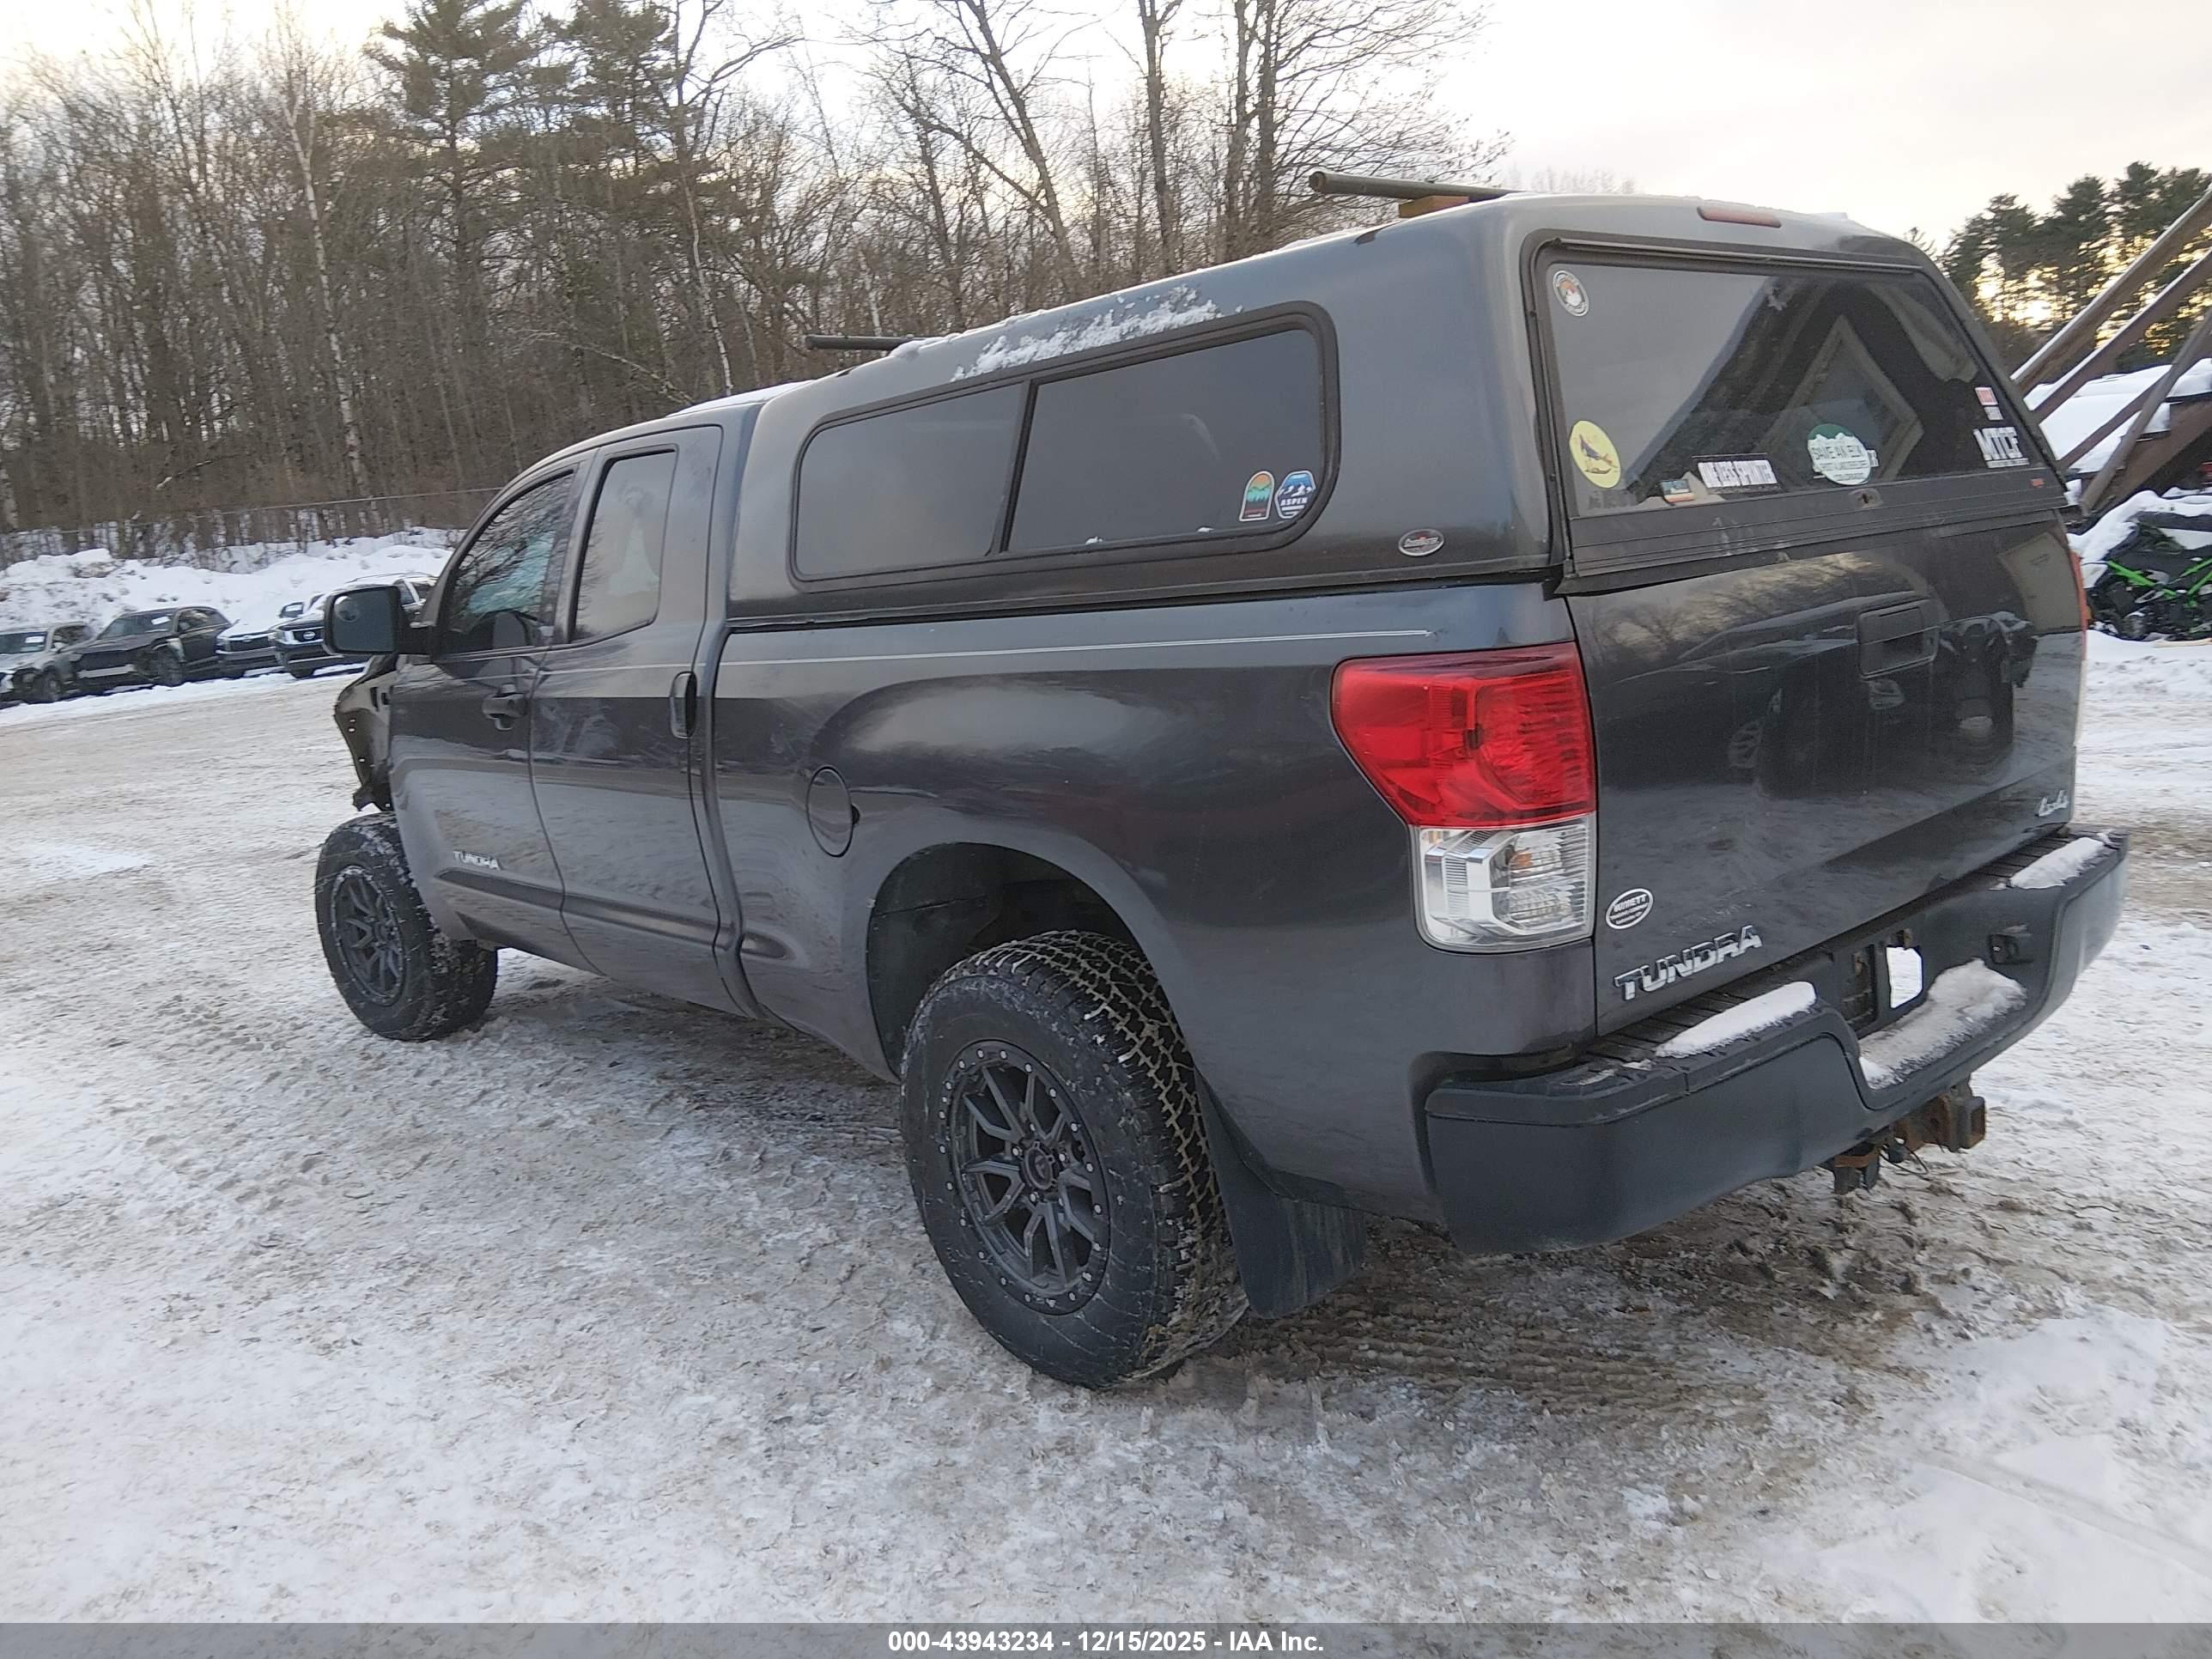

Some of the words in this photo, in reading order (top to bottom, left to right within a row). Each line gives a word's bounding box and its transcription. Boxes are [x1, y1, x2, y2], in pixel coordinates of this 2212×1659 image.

[1280, 497, 1308, 507] ASPEN
[453, 851, 501, 870] TUNDRA
[1614, 925, 1763, 1000] TUNDRA
